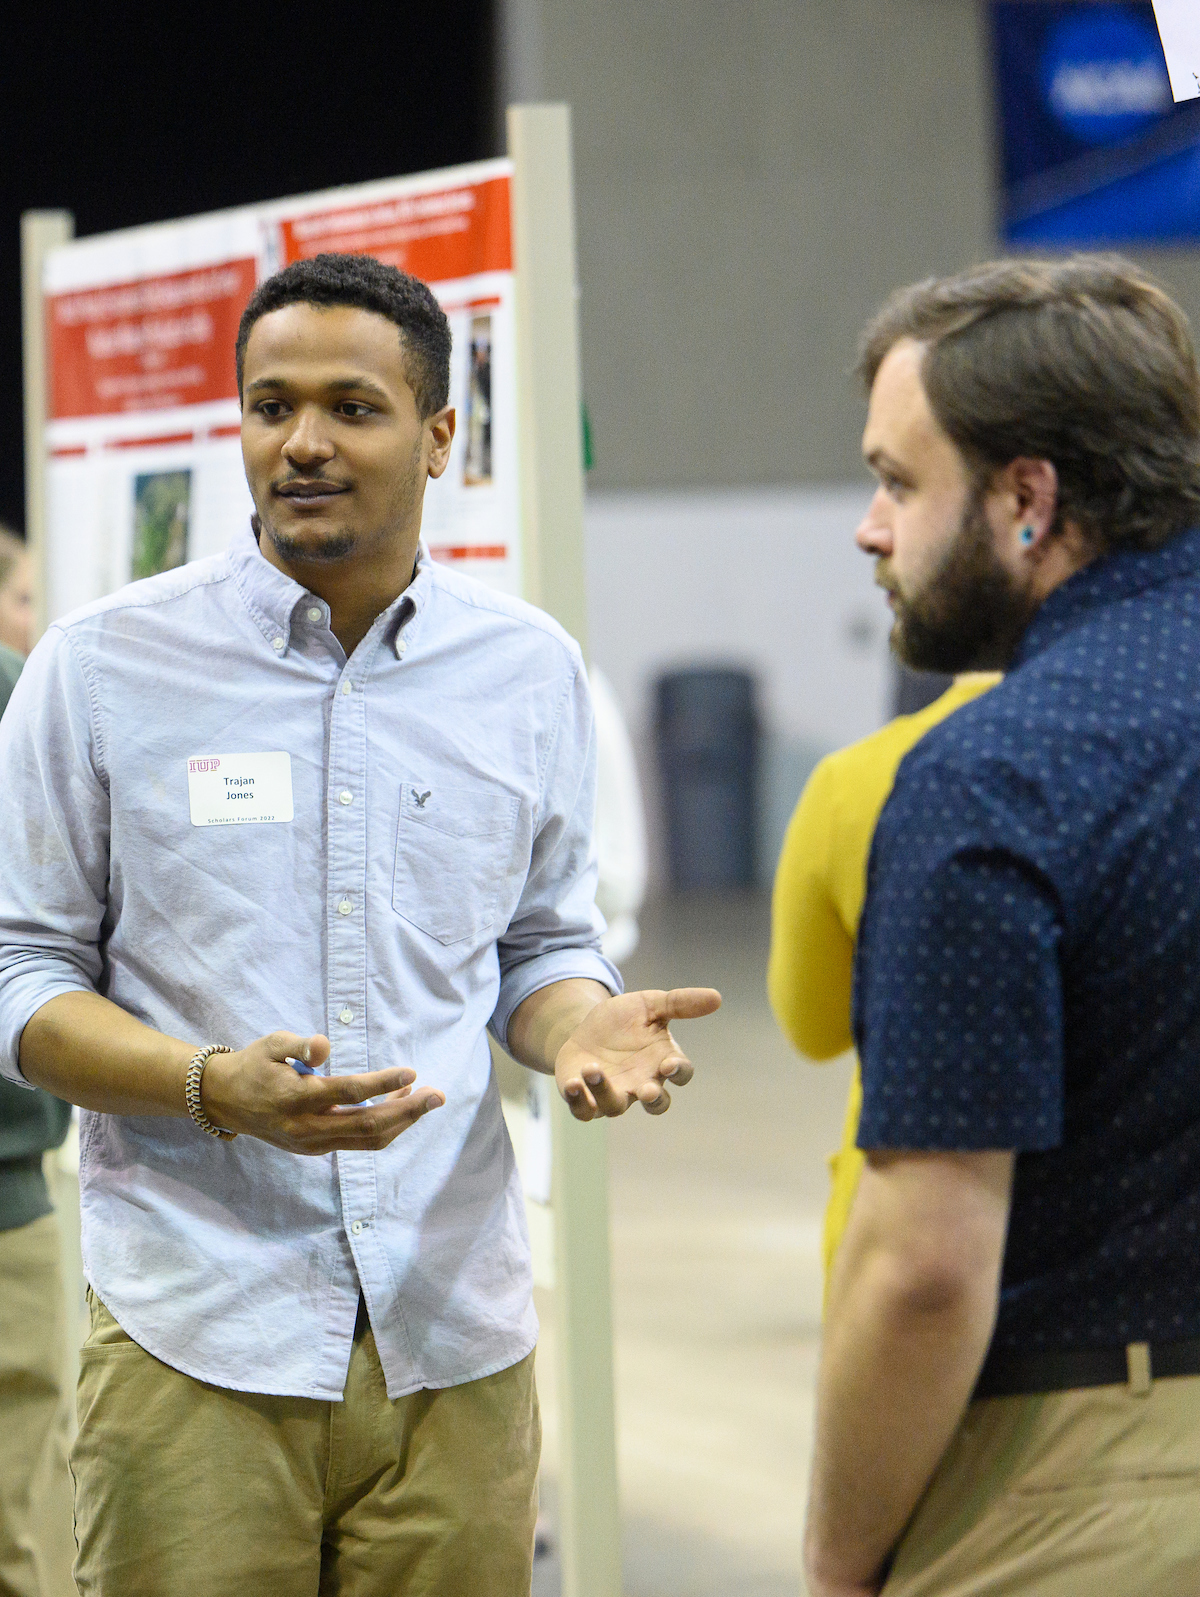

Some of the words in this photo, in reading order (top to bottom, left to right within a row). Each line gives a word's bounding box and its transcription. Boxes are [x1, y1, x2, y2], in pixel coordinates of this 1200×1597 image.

[189, 758, 220, 773] IUP
[223, 776, 255, 787] Trajan
[226, 791, 254, 800] Jones
